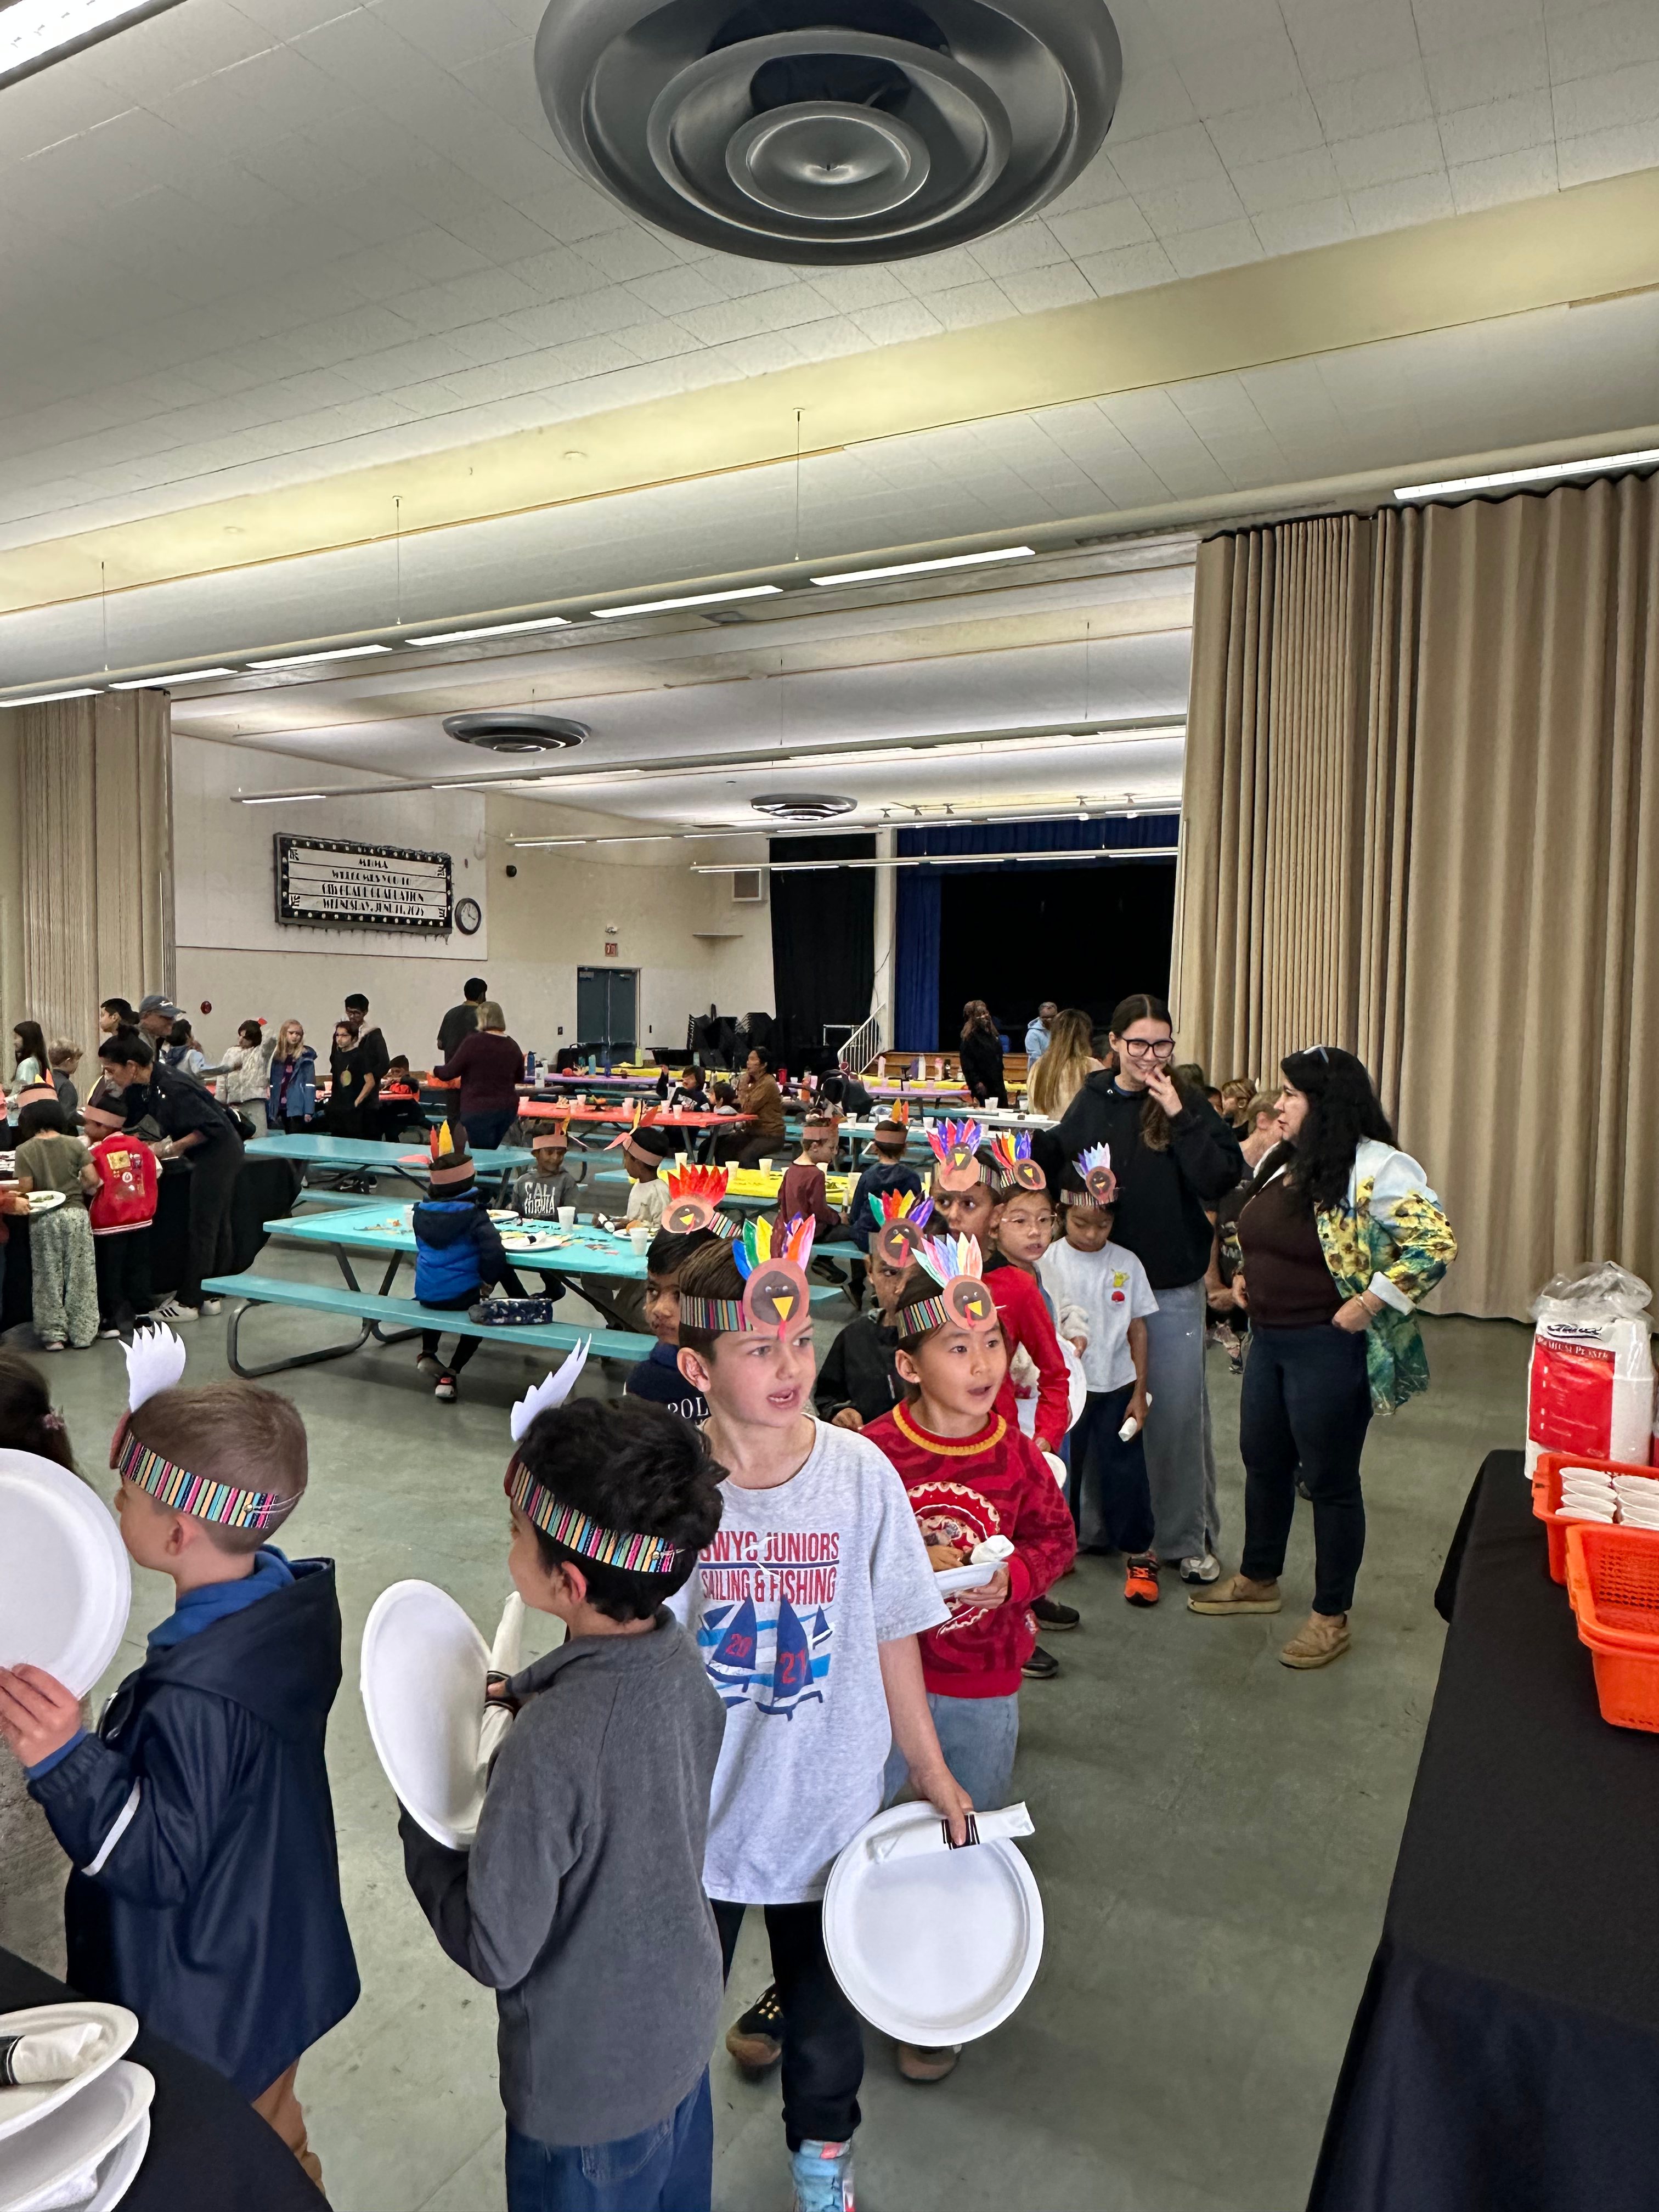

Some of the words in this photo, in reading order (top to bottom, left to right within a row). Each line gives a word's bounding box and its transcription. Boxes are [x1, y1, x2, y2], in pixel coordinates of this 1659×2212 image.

[764, 1532, 840, 1562] JUNIORS
[702, 1569, 751, 1601] SAILING
[754, 1570, 765, 1602] &
[770, 1566, 837, 1605] FISHING
[725, 1633, 753, 1658] 20
[780, 1649, 806, 1684] 21
